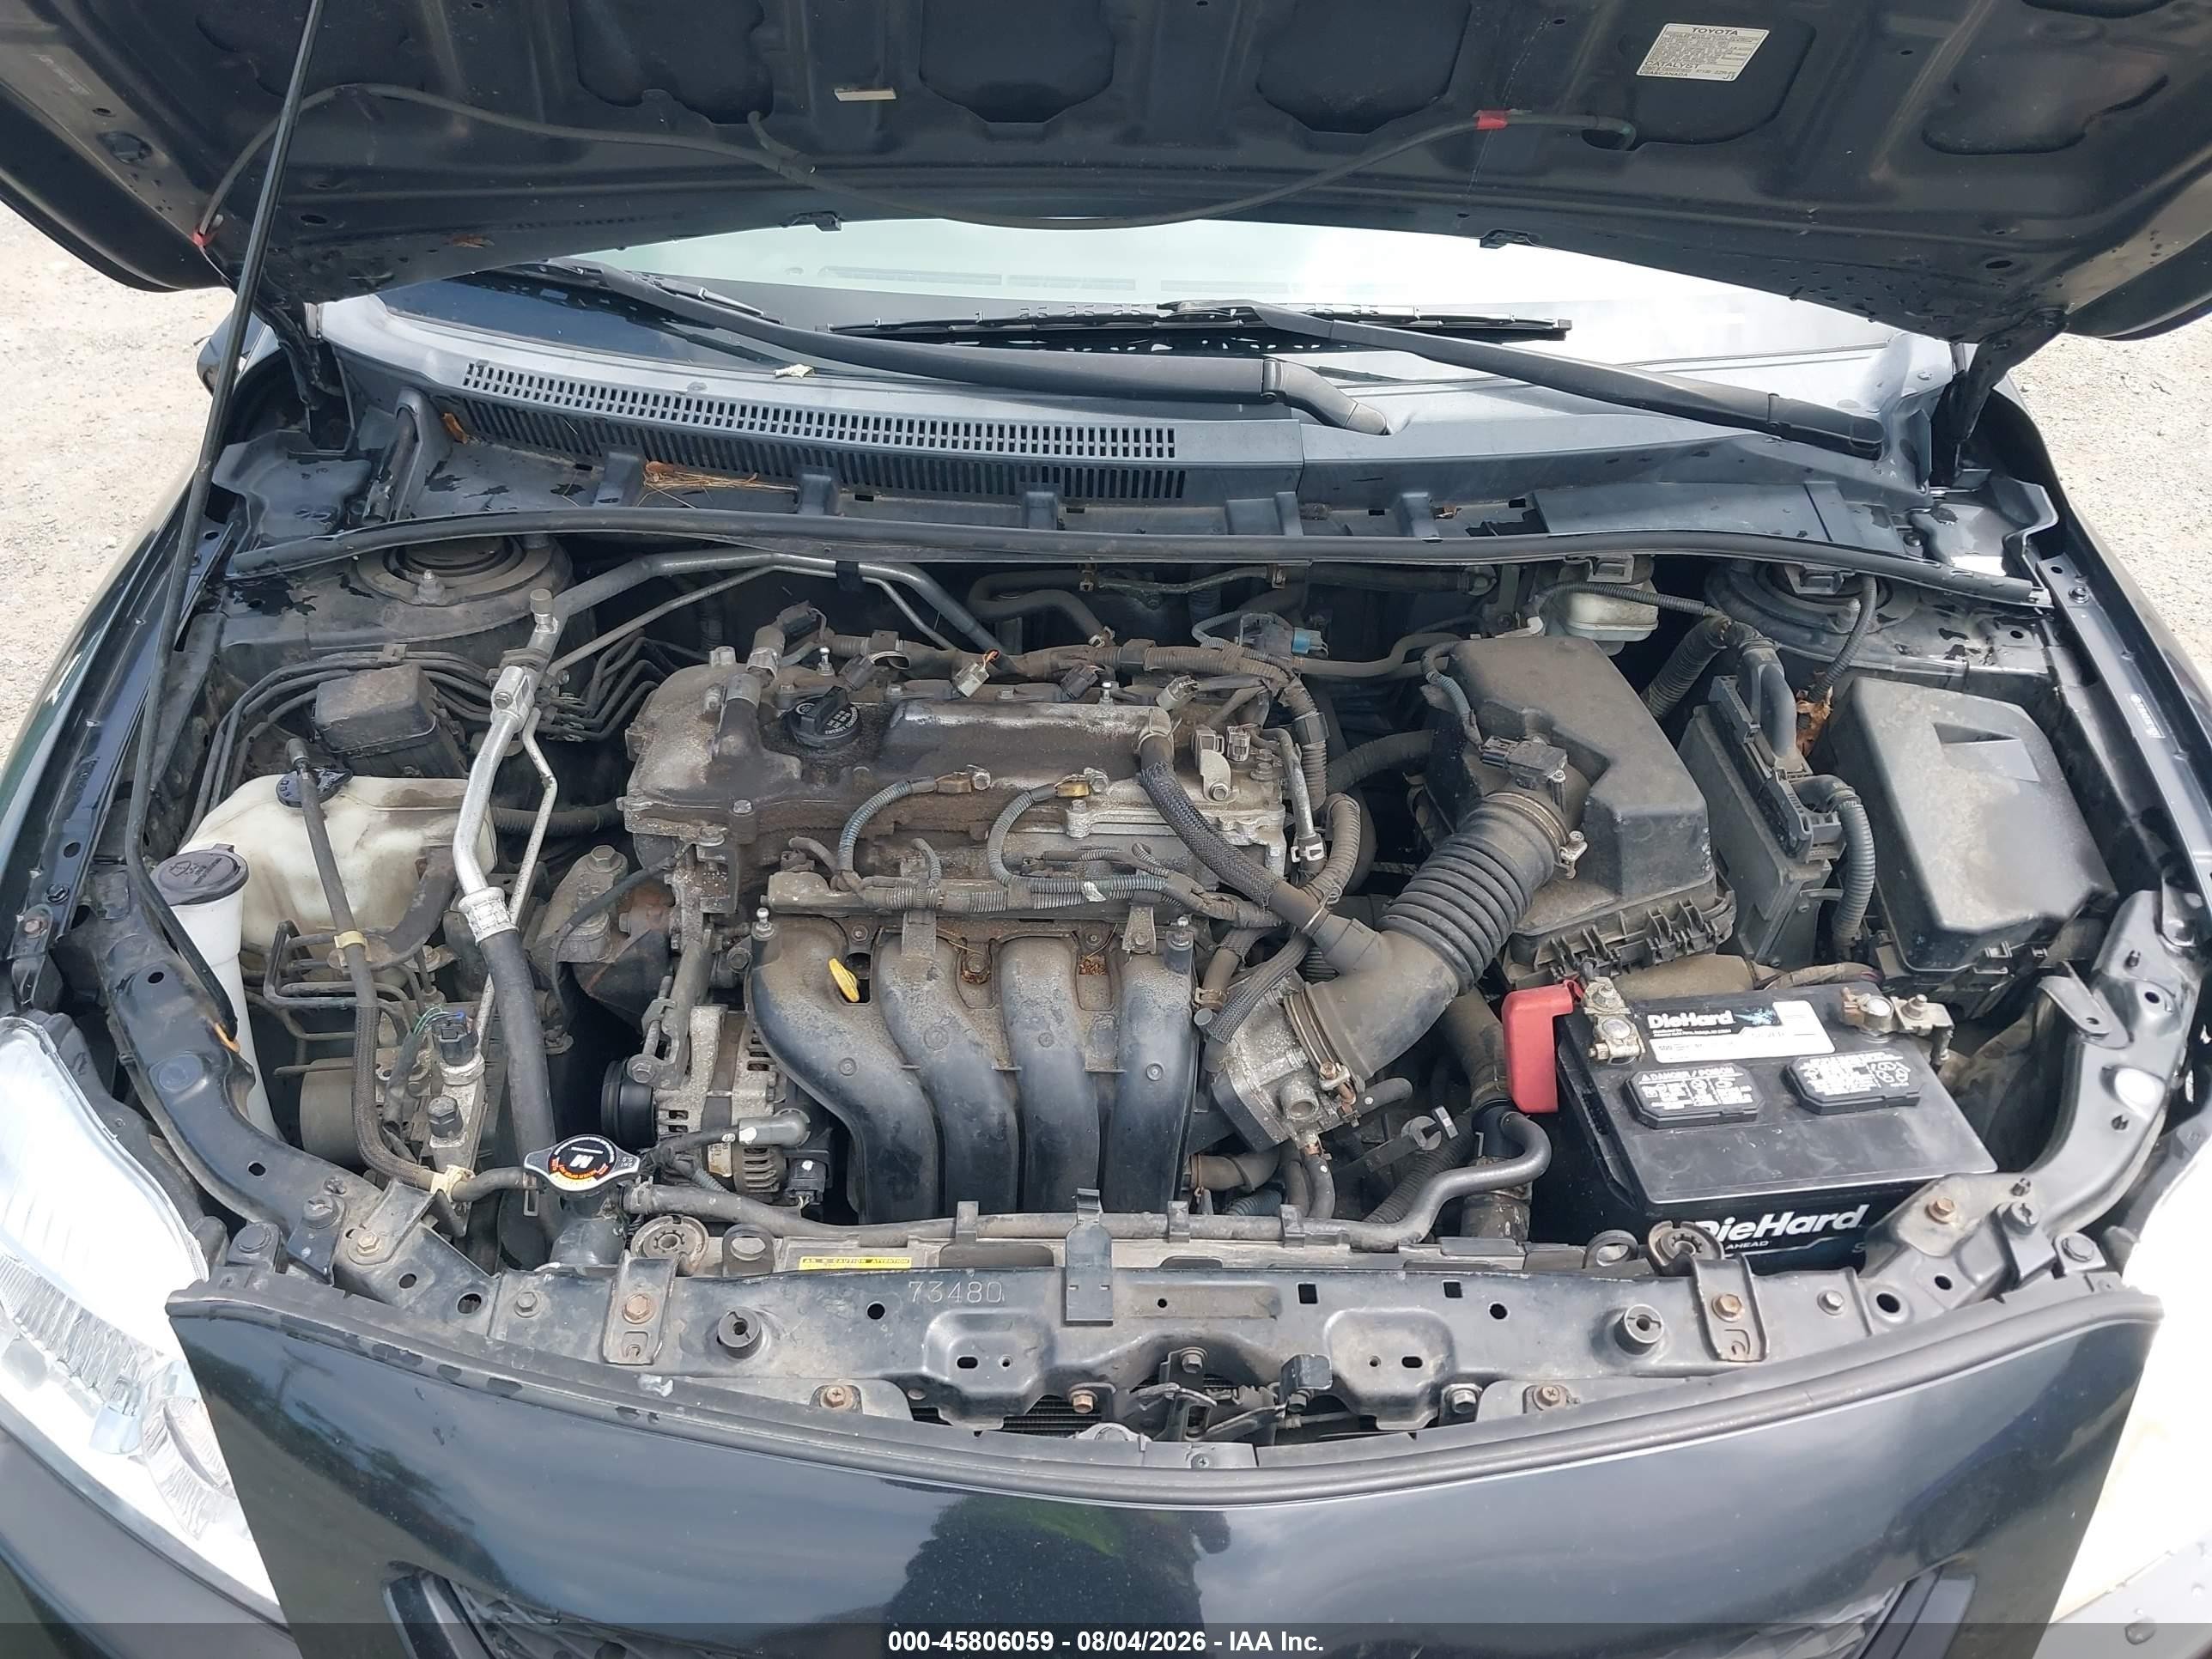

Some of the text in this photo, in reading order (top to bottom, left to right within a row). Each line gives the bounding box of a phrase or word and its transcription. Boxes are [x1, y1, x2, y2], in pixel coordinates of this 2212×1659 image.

[1647, 1009, 1735, 1030] DieHard
[1698, 1066, 1735, 1076] POISON
[1726, 1241, 1769, 1250] AHEAD
[908, 1281, 1004, 1304] 73480
